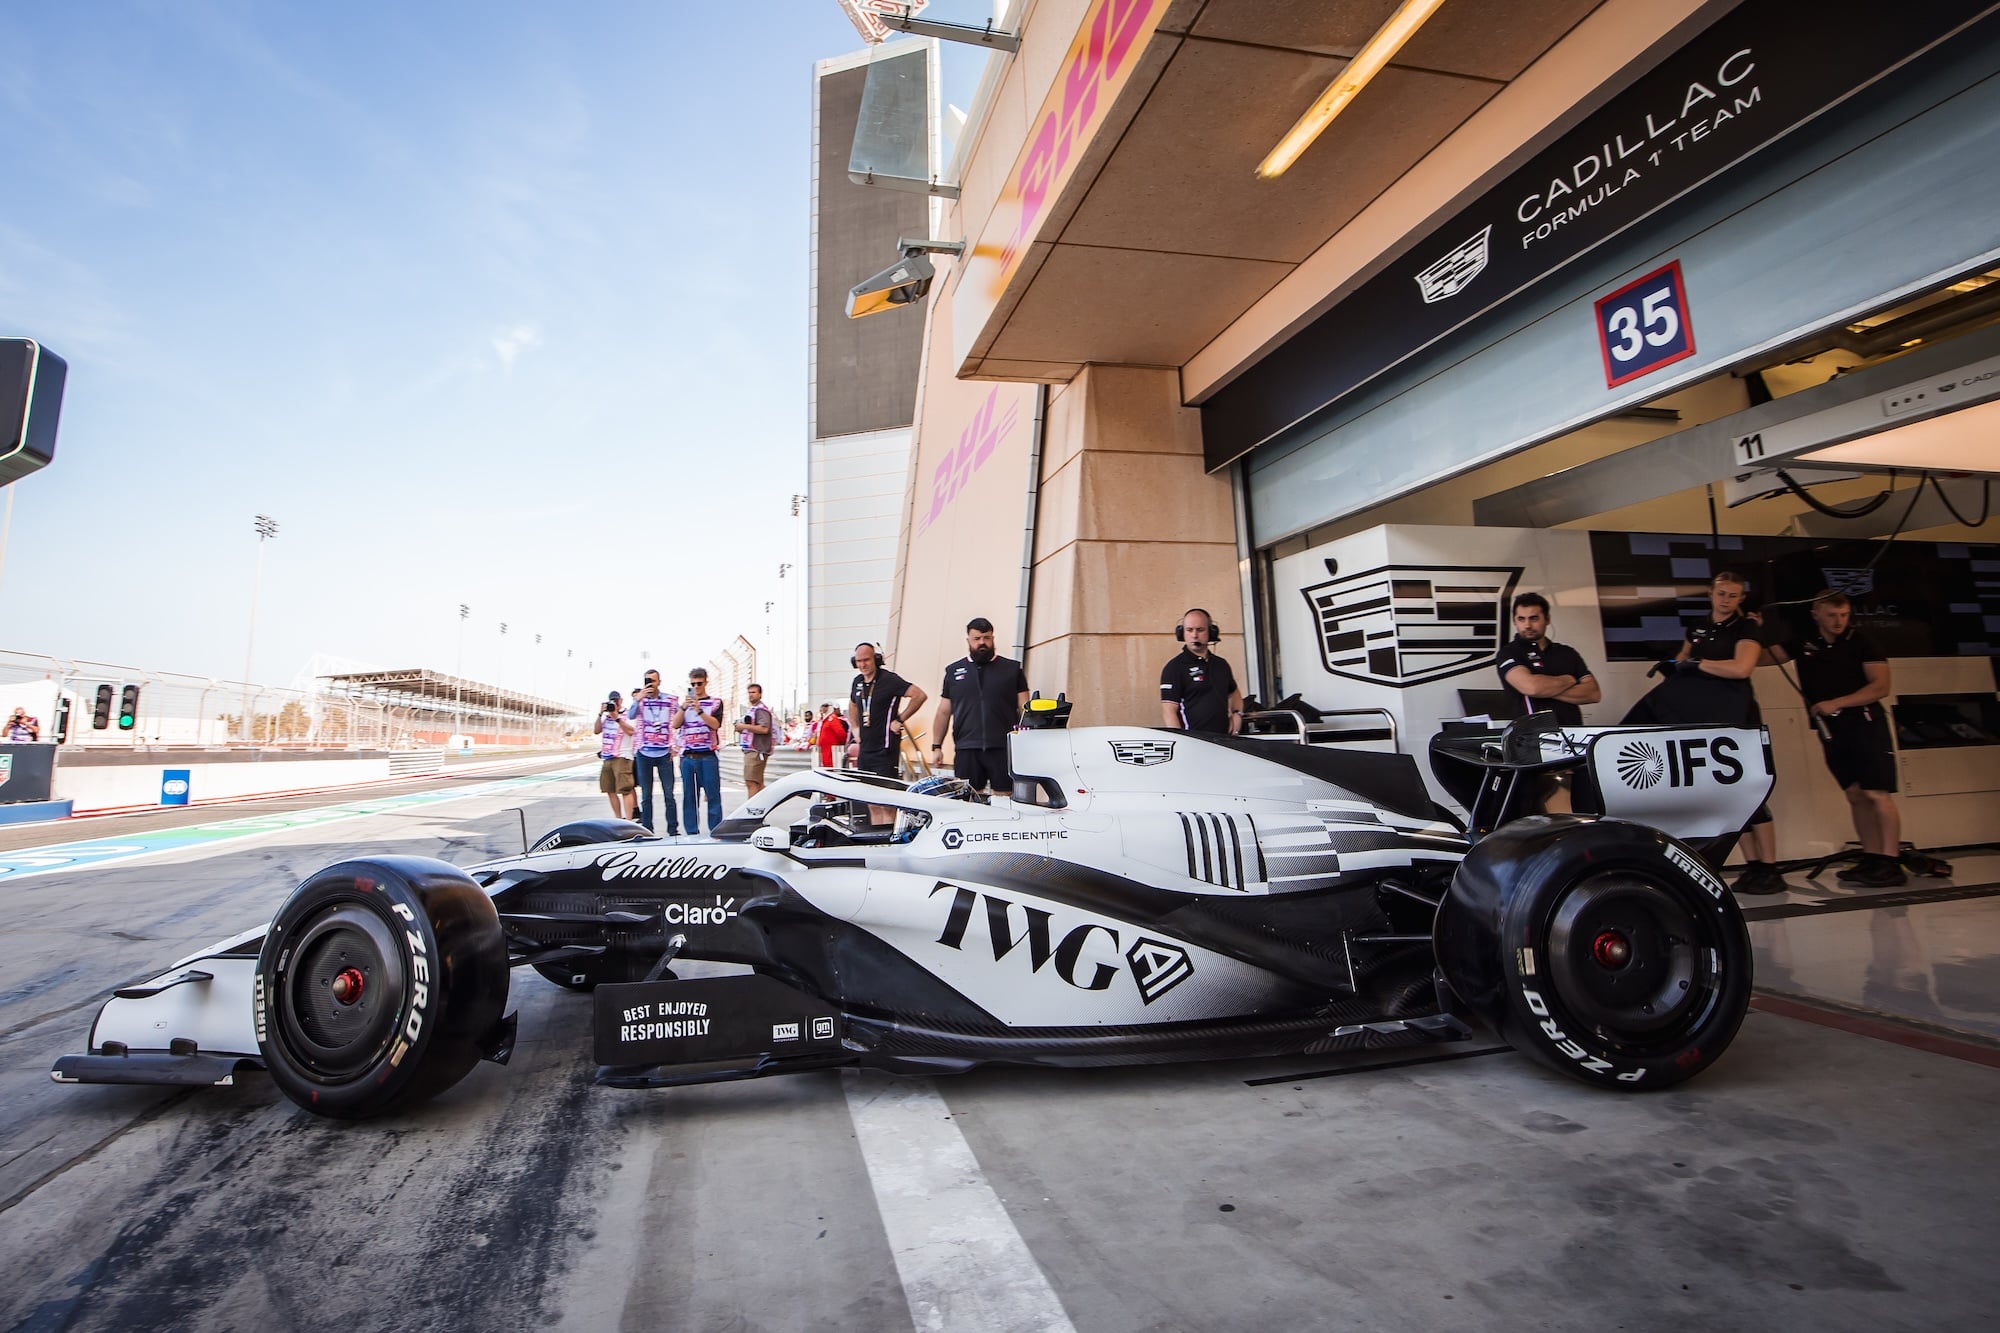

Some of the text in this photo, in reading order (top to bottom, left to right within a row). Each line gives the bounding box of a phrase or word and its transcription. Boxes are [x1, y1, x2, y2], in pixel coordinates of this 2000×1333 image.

[1517, 48, 1756, 223] CADILLAC
[1522, 168, 1641, 250] FORMULA
[1669, 86, 1762, 151] TEAM
[1608, 286, 1679, 362] 35
[926, 383, 1002, 528] DHL
[1739, 433, 1764, 459] 11
[1666, 736, 1744, 788] IFS
[966, 830, 1068, 842] CORE SCIENTIFIC
[596, 851, 728, 882] Cadillac
[1663, 842, 1724, 899] PIRELLI
[665, 901, 729, 925] Claro
[928, 880, 1120, 991] TWG
[391, 902, 430, 1042] P ZERO
[255, 973, 267, 1043] PIRELLI
[620, 1018, 711, 1042] RESPONSIBLY
[623, 1001, 708, 1023] BEST ENJOYED
[775, 1025, 796, 1036] TWG
[816, 1022, 830, 1034] gm
[1522, 989, 1615, 1075] ZERO
[1616, 1067, 1647, 1082] P
